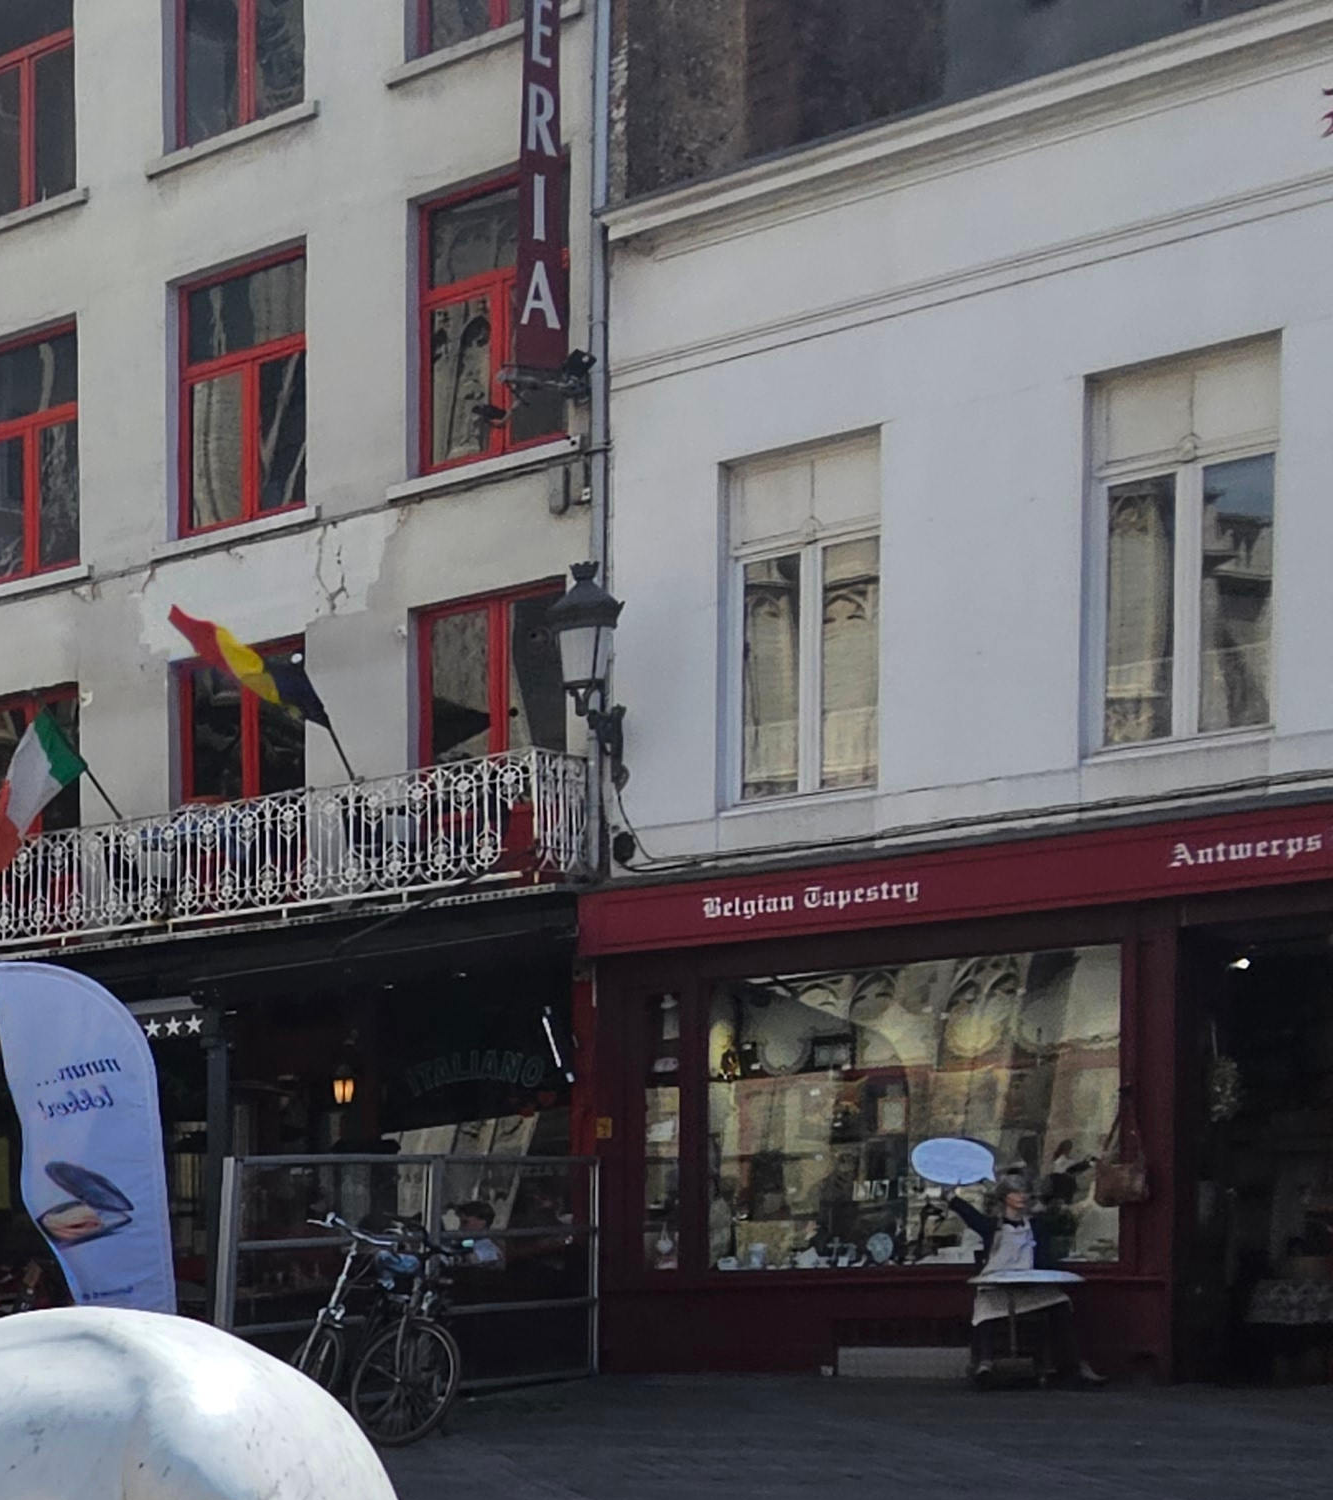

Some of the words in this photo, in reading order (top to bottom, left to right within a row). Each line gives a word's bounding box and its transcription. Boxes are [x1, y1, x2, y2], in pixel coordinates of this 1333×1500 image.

[1167, 834, 1323, 868] Antwerps
[702, 895, 795, 919] Belgian
[803, 881, 920, 910] Tapestry
[407, 1049, 545, 1096] ITALIANO
